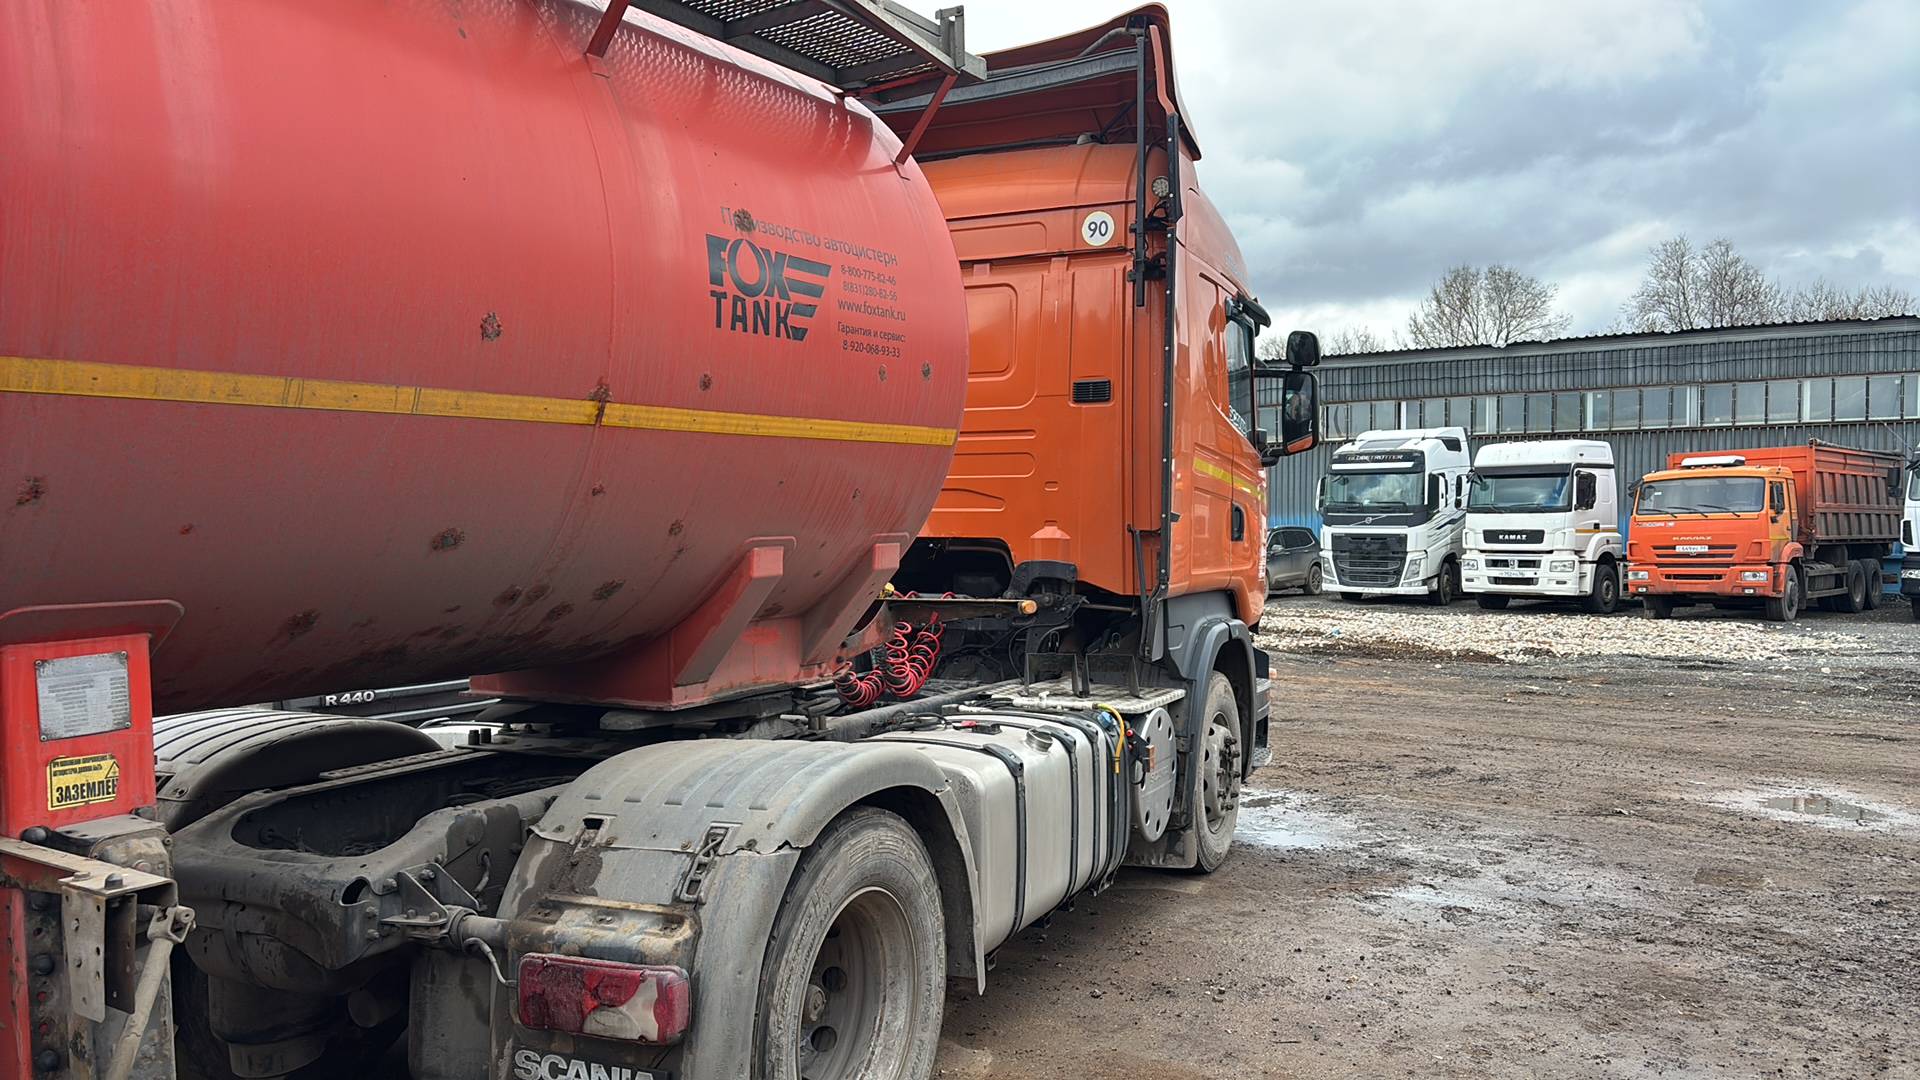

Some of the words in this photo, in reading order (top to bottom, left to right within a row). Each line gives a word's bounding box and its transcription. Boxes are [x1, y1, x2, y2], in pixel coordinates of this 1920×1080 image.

[720, 206, 821, 246] Пизводство
[824, 236, 899, 266] автоцистерн
[1088, 220, 1108, 238] 90
[706, 233, 791, 301] FOX
[709, 290, 793, 340] TANK
[837, 298, 907, 321] www.foxtank.ru
[837, 321, 872, 337] Гарантия
[325, 695, 338, 706] R
[339, 690, 375, 704] 440
[514, 1049, 655, 1080] SCAN
